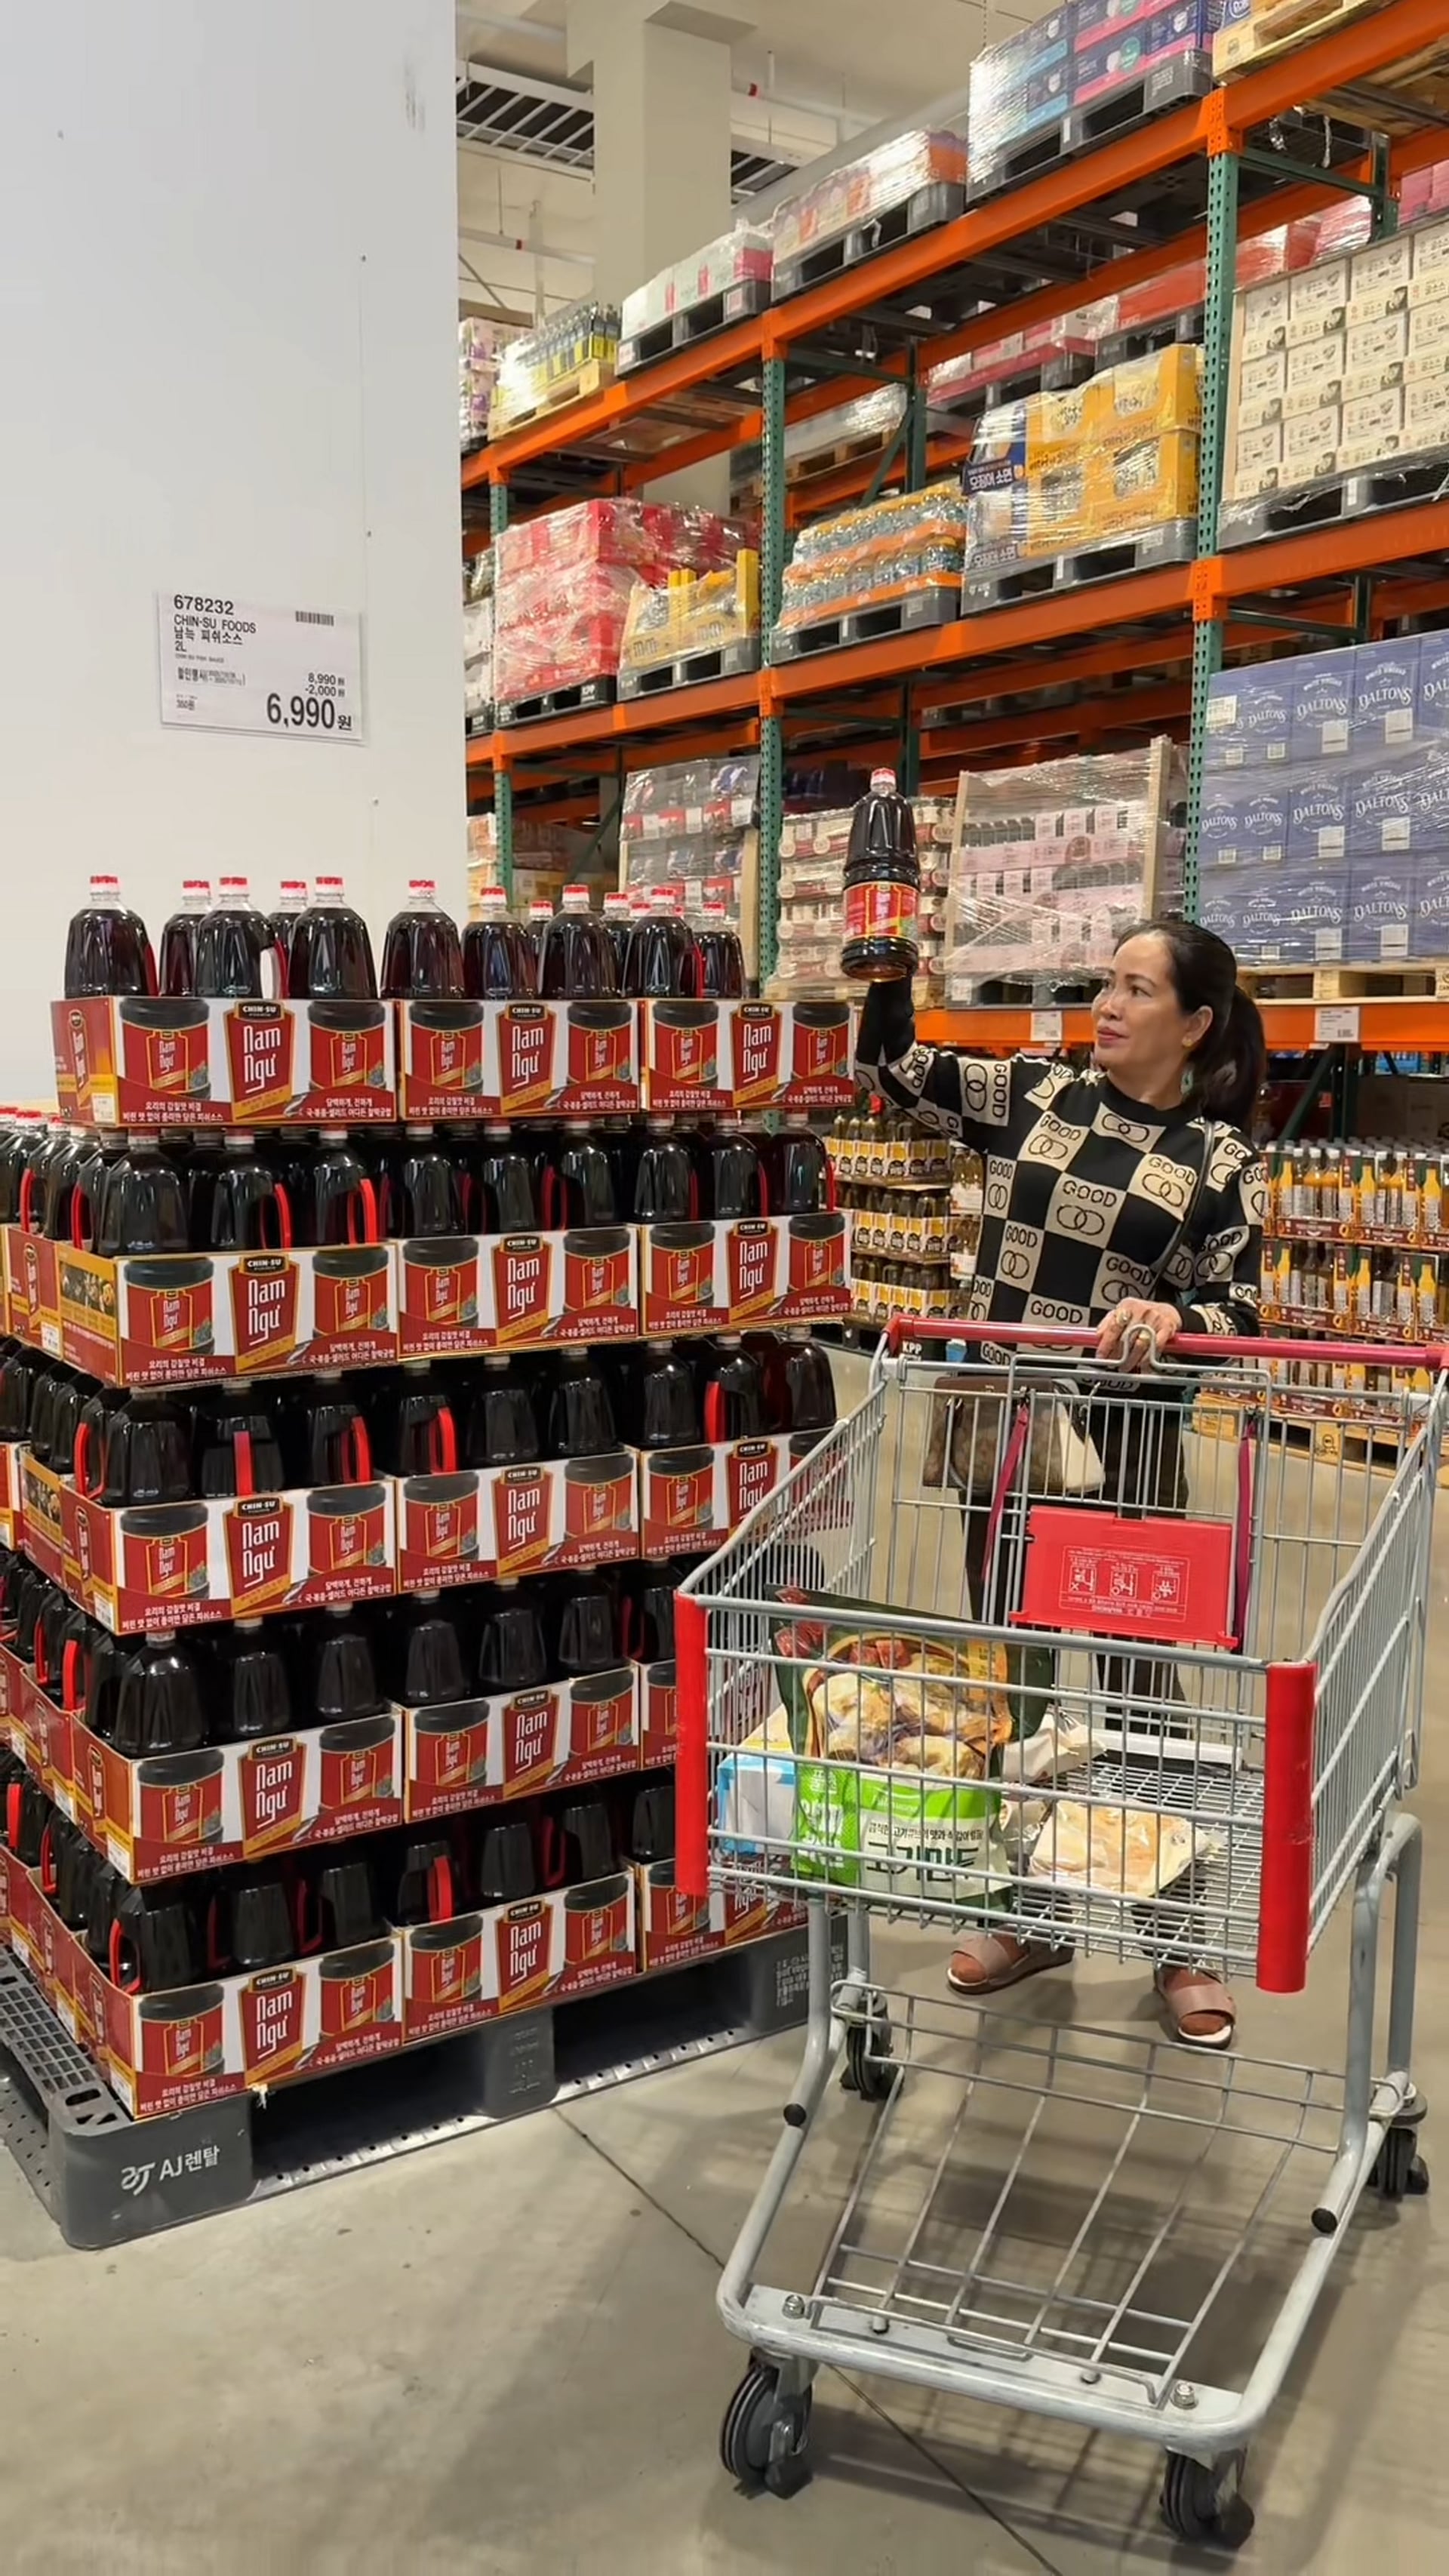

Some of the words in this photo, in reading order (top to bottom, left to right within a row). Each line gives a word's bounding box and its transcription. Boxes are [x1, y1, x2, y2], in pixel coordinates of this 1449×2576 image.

[174, 595, 234, 616] 678232
[174, 614, 217, 629] CHIN-SU
[222, 620, 257, 634] FOODS
[201, 629, 243, 645] 피쉬소스
[175, 642, 187, 652] 2L
[1297, 697, 1349, 720] DALTONS
[1358, 687, 1413, 712] DALTONS
[1294, 803, 1345, 824] DALTONS
[1291, 904, 1343, 925] DALTONS
[1354, 901, 1408, 922] DALTONS
[243, 1025, 280, 1053] Nam
[512, 1025, 543, 1051] Nam
[743, 1023, 771, 1048] Nam
[244, 1053, 276, 1094] Ngư
[512, 1051, 539, 1088] Ngư
[743, 1048, 767, 1083] Ngư
[992, 1063, 1008, 1119] GOOD
[1041, 1114, 1081, 1141] GOOD
[989, 1159, 1013, 1180] GOOD
[1149, 1156, 1197, 1186] GOOD
[1062, 1180, 1118, 1208] GOOD
[1005, 1224, 1038, 1248] GOOD
[740, 1241, 767, 1265] Nam
[507, 1257, 539, 1283] Nam
[739, 1263, 763, 1299] Ngư
[248, 1279, 285, 1306] Nam
[507, 1281, 535, 1319] Ngư
[248, 1304, 280, 1345] Ngư
[1030, 1300, 1083, 1324] GOOD
[903, 1340, 922, 1355] KPP
[739, 1460, 768, 1486] Nam
[242, 1500, 275, 1510] CHIN-SU
[508, 1488, 540, 1514] Nam
[242, 1520, 279, 1549] Nam
[508, 1511, 535, 1550] Ngư
[243, 1546, 275, 1587] Ngư
[515, 1710, 547, 1738] Nam
[515, 1733, 542, 1772] Ngư
[256, 1760, 292, 1791] Nam
[256, 1785, 287, 1828] Ngư
[866, 1842, 980, 1882] 고기만두
[510, 1921, 541, 1950] Nam
[510, 1944, 537, 1985] Ngư
[257, 1990, 291, 2022] Nam
[257, 2014, 288, 2058] Ngư
